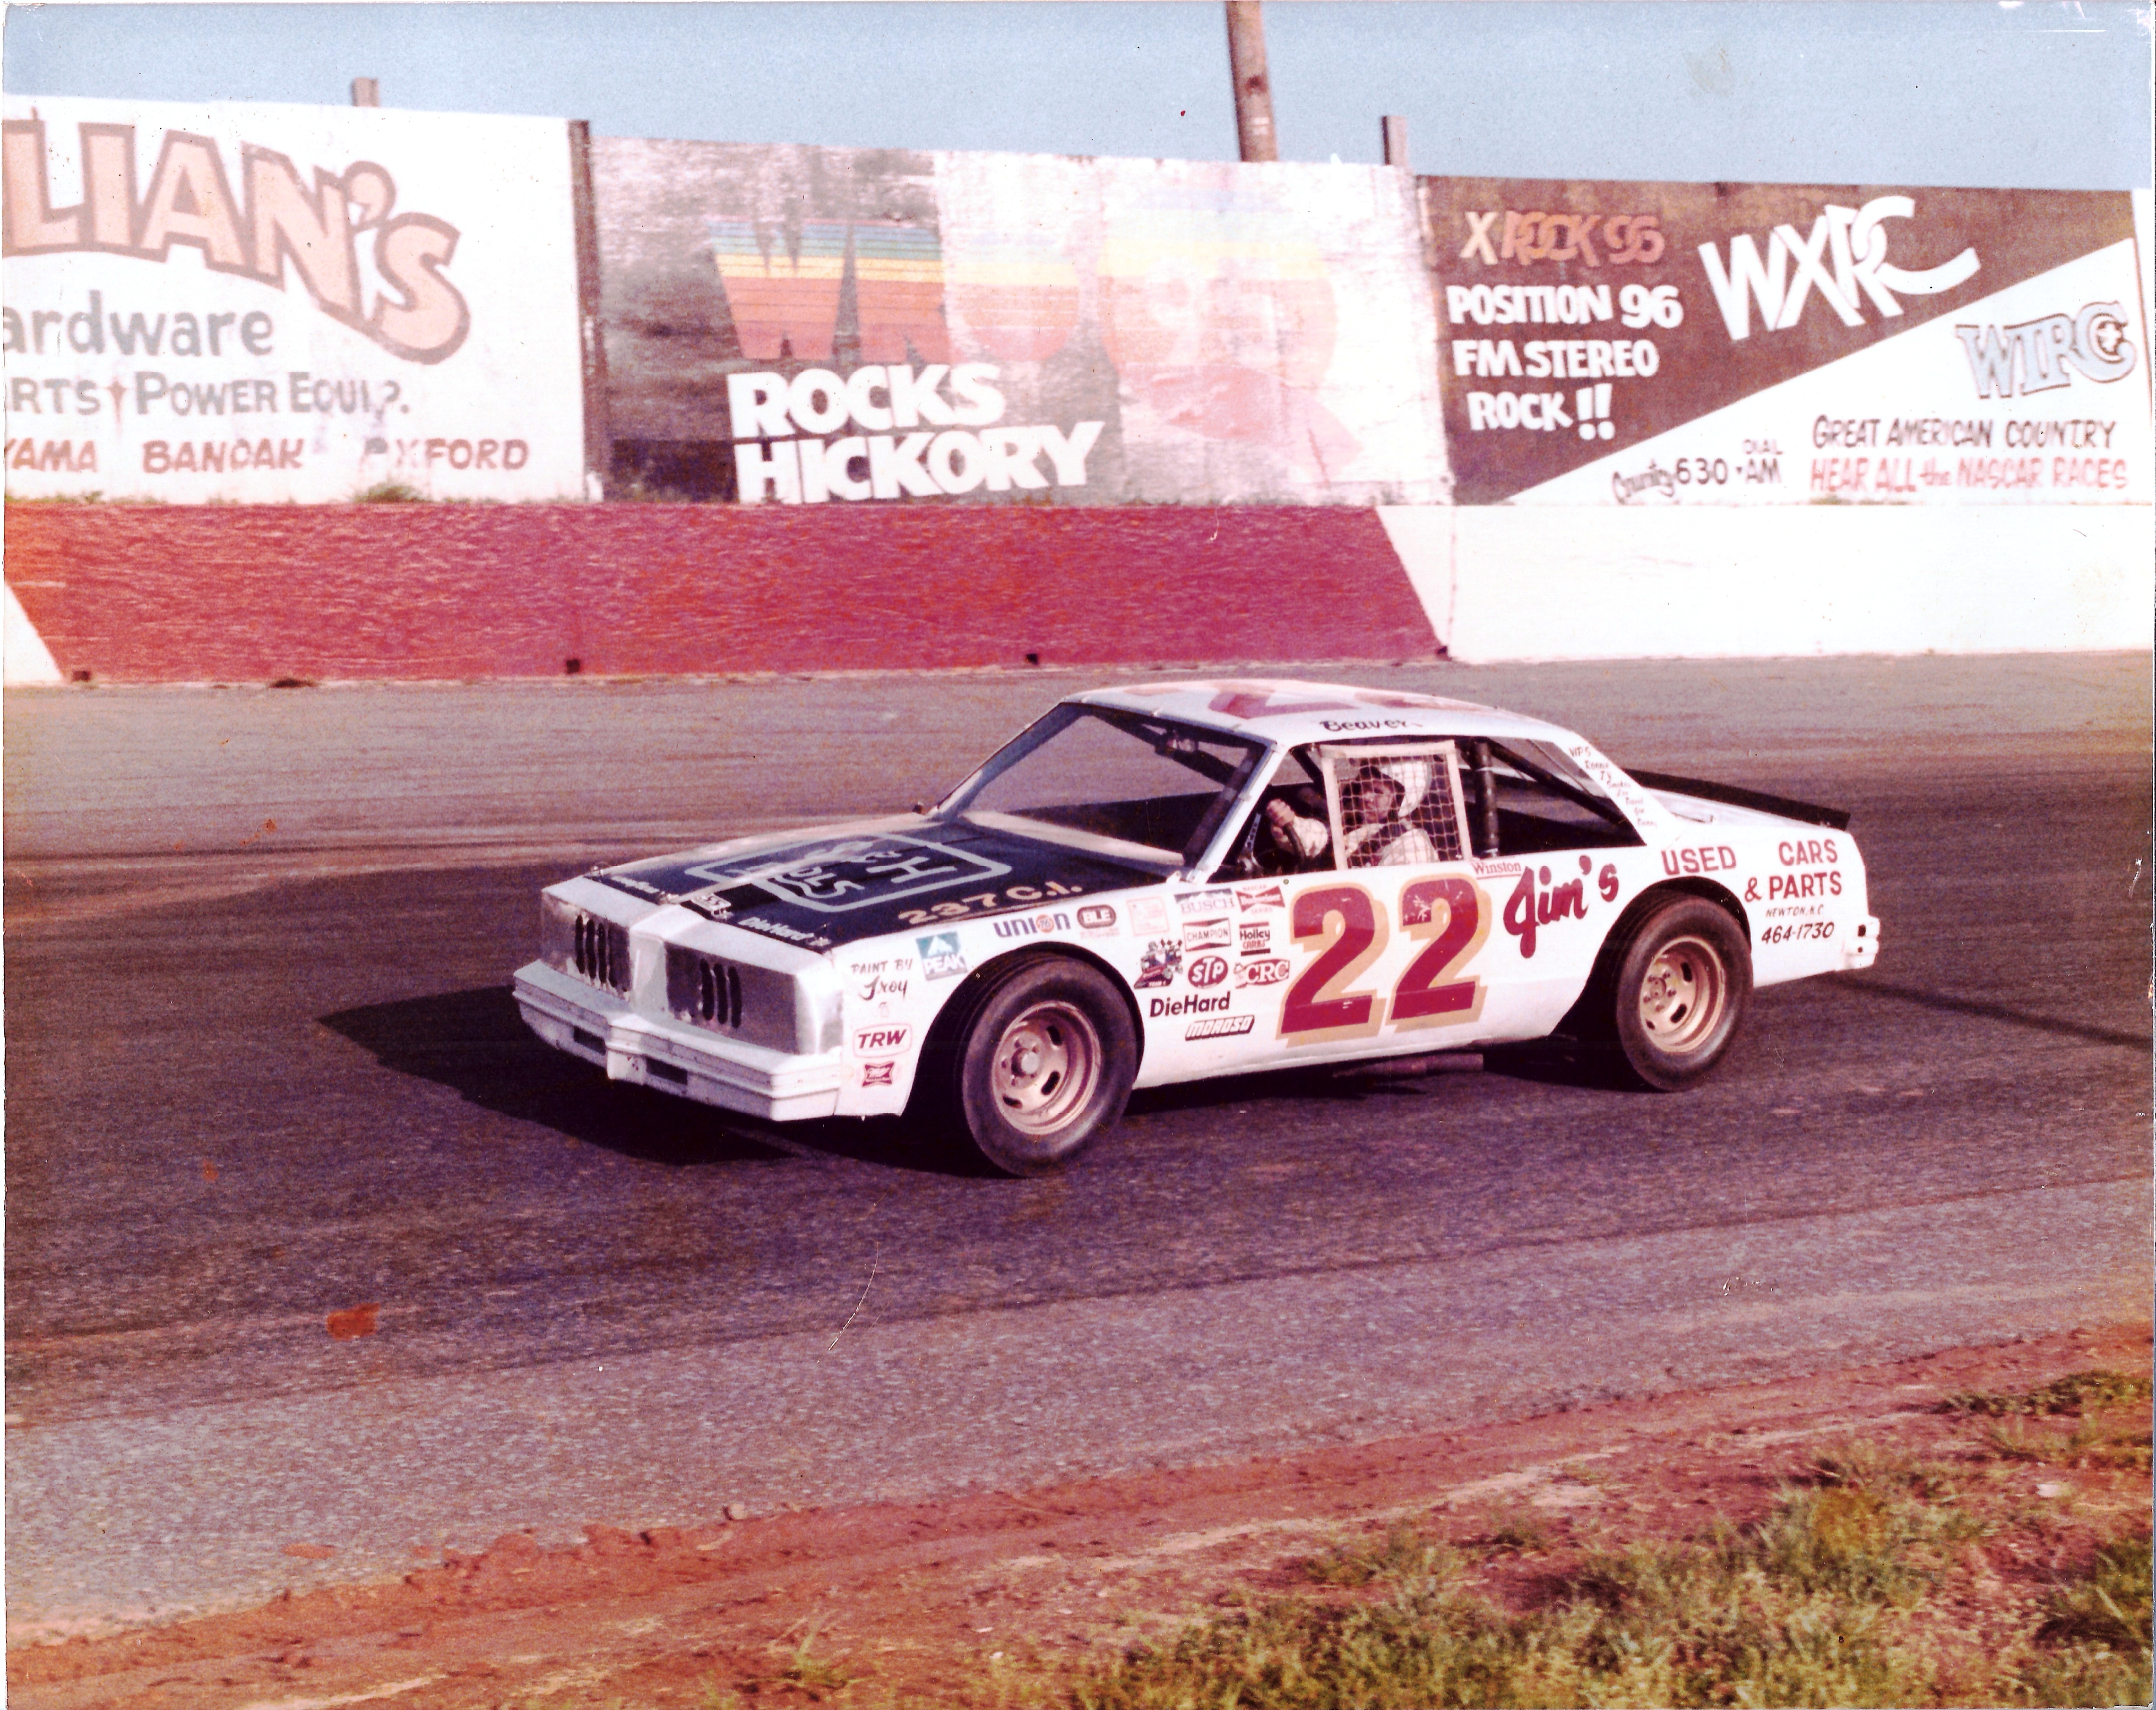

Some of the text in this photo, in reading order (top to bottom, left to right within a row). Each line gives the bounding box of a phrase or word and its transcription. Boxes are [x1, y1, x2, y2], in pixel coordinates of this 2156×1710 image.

[1604, 215, 1665, 264] 96
[1699, 195, 1982, 341] WXRC
[1446, 284, 1684, 328] POSITION 96
[1452, 339, 1660, 378] FM STEREO
[1955, 301, 2138, 399] WIRC
[135, 371, 277, 416] POWER
[725, 362, 1006, 438] ROCKS
[1812, 414, 2117, 449] GREAT AMERICAN COUNTRY
[734, 421, 1105, 505] HICKORY
[1675, 457, 1728, 485] 630
[1745, 457, 1782, 484] AM
[1811, 457, 1869, 492] HEAR
[1875, 457, 1917, 492] ALL
[1957, 457, 2044, 490] NASCAR
[2052, 456, 2128, 490] RACES
[1319, 720, 1407, 732] Beaver
[1472, 861, 1522, 874] Winston
[1503, 838, 1838, 959] Jim's USED CARS
[1744, 870, 1843, 903] & PARTS
[898, 893, 997, 925] 237
[1180, 897, 1235, 914] BUSCH
[1186, 928, 1229, 942] CHAMPION
[1240, 928, 1270, 942] Holley
[1761, 922, 1835, 945] 464-1730
[851, 960, 888, 974] PAINT
[922, 952, 966, 976] PEAK
[1191, 957, 1225, 984] STP
[1245, 961, 1289, 983] CRC
[1277, 873, 1492, 1048] 22
[1149, 990, 1231, 1018] DieHard
[858, 1029, 907, 1049] TRW
